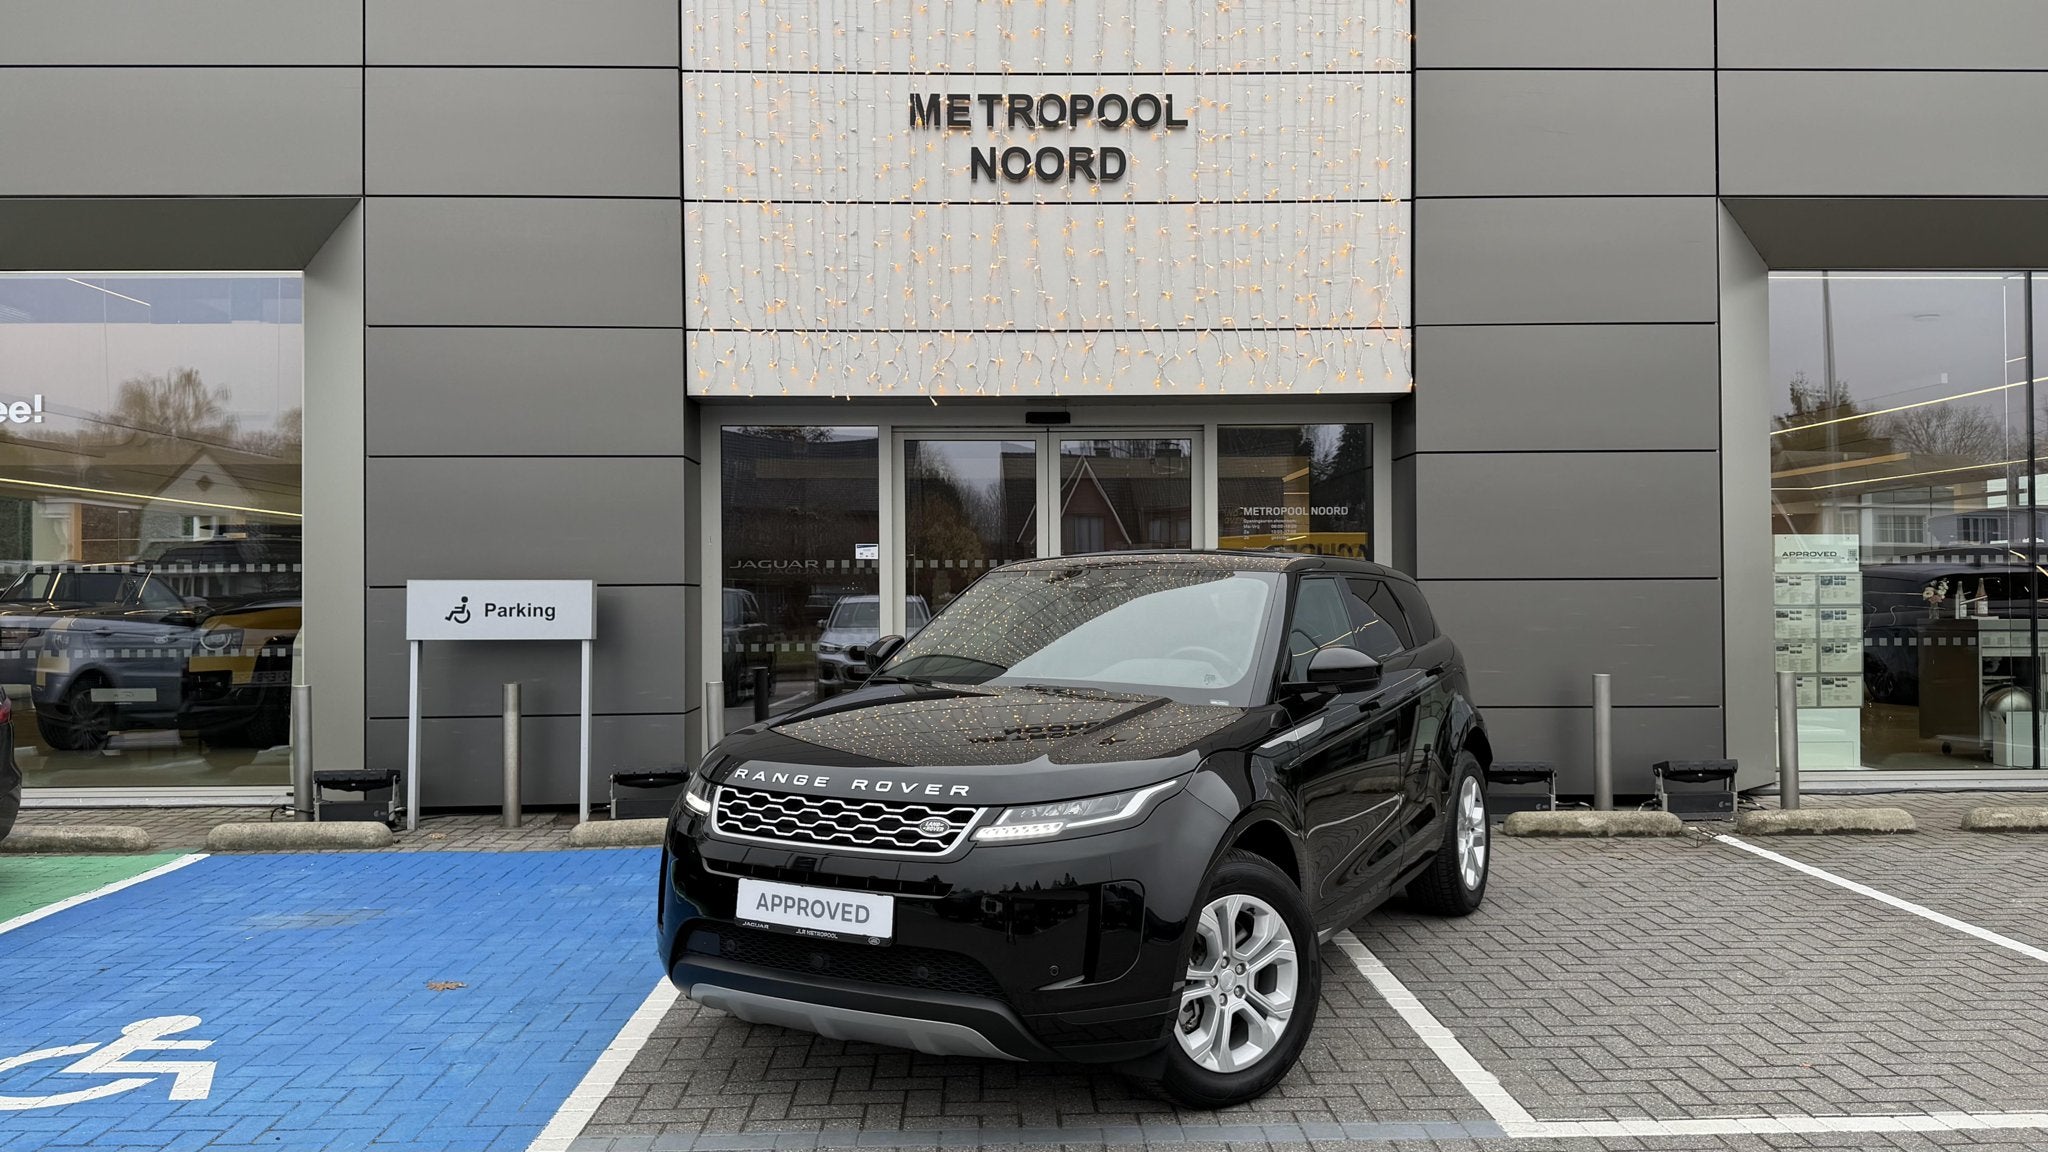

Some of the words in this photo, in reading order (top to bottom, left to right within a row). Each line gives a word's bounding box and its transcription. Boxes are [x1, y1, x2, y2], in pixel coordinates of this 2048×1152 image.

[909, 93, 1189, 128] METROPOOL
[970, 146, 1127, 182] NOORD
[1243, 506, 1308, 516] METROPOOL
[1310, 506, 1349, 516] NOORD
[729, 559, 819, 569] JAGUAR
[484, 602, 556, 621] Parking
[734, 768, 830, 787] RANGE
[851, 779, 970, 796] ROVER
[756, 892, 870, 924] APPROVED
[742, 920, 769, 930] JAGUAR
[806, 929, 839, 939] METROPOOL
